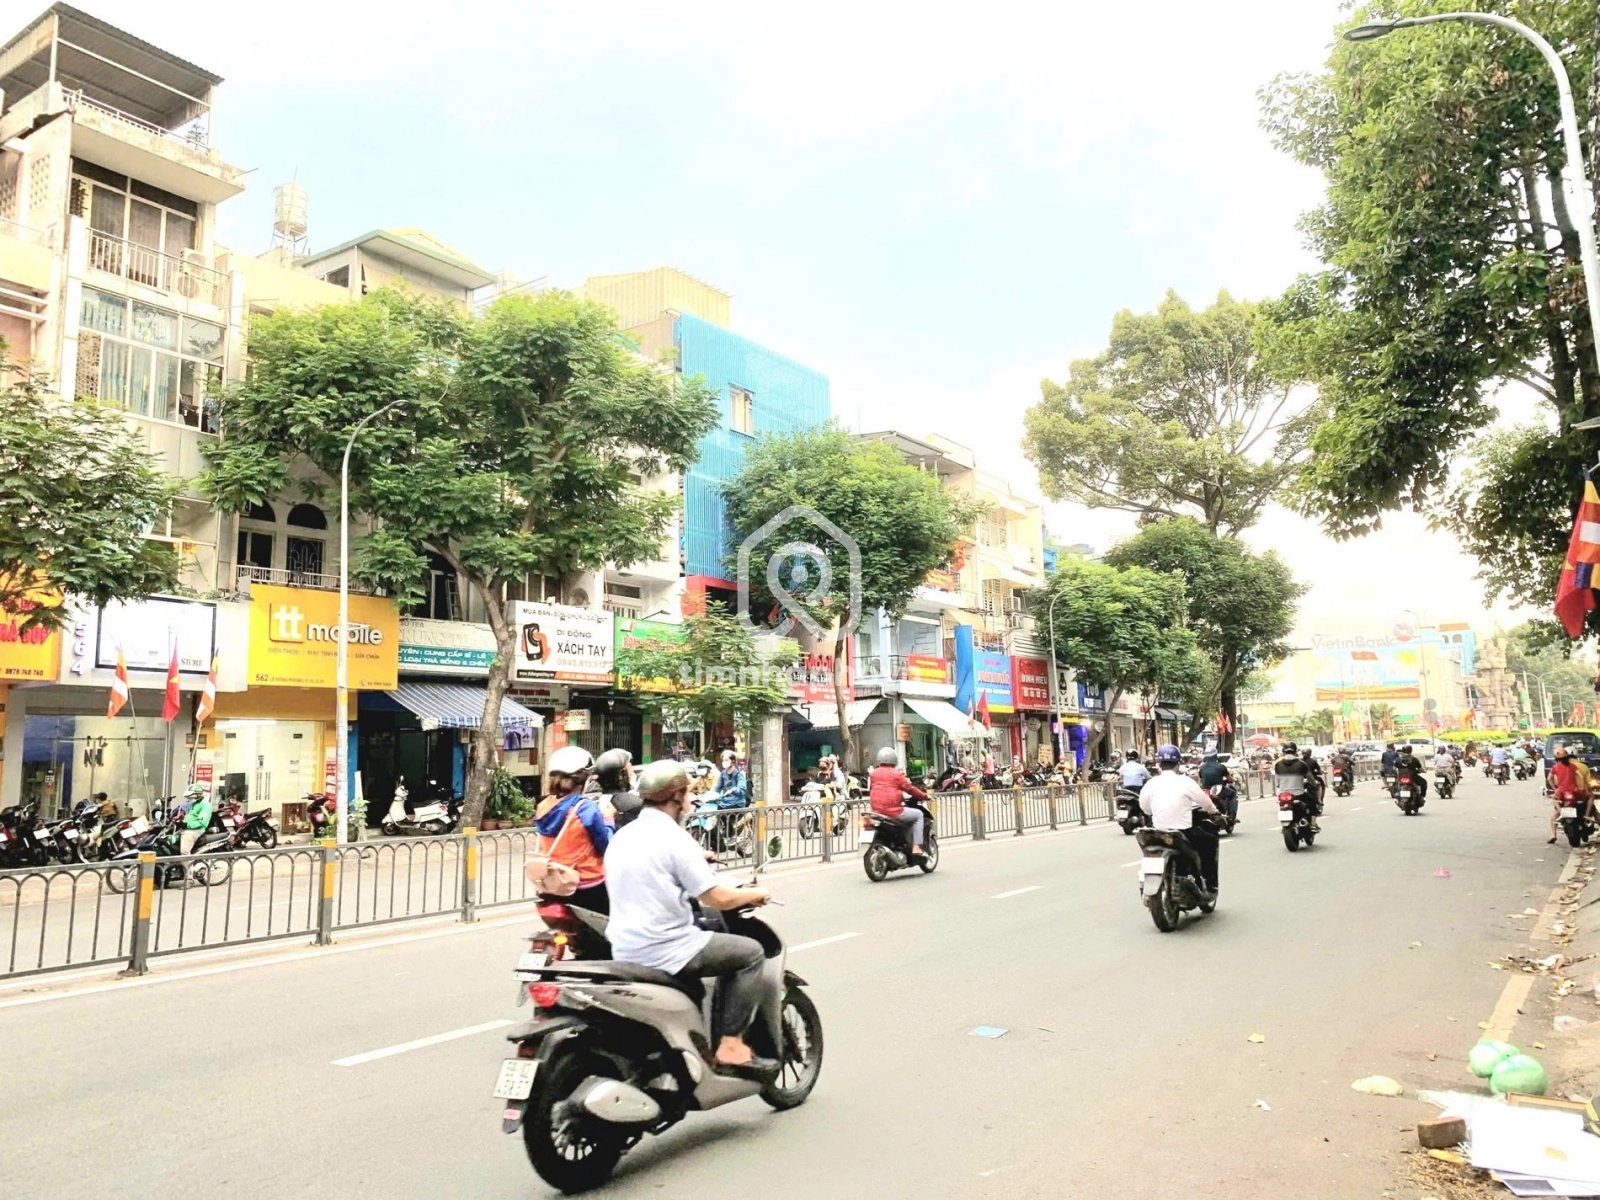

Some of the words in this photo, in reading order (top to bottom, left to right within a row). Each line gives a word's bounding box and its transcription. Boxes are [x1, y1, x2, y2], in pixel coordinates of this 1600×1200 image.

[567, 630, 592, 638] ĐỘNG
[1311, 634, 1394, 649] VietinBank
[424, 649, 446, 657] CUNG
[557, 640, 584, 655] XÁCH
[588, 644, 607, 657] TAY
[181, 658, 203, 667] STORE
